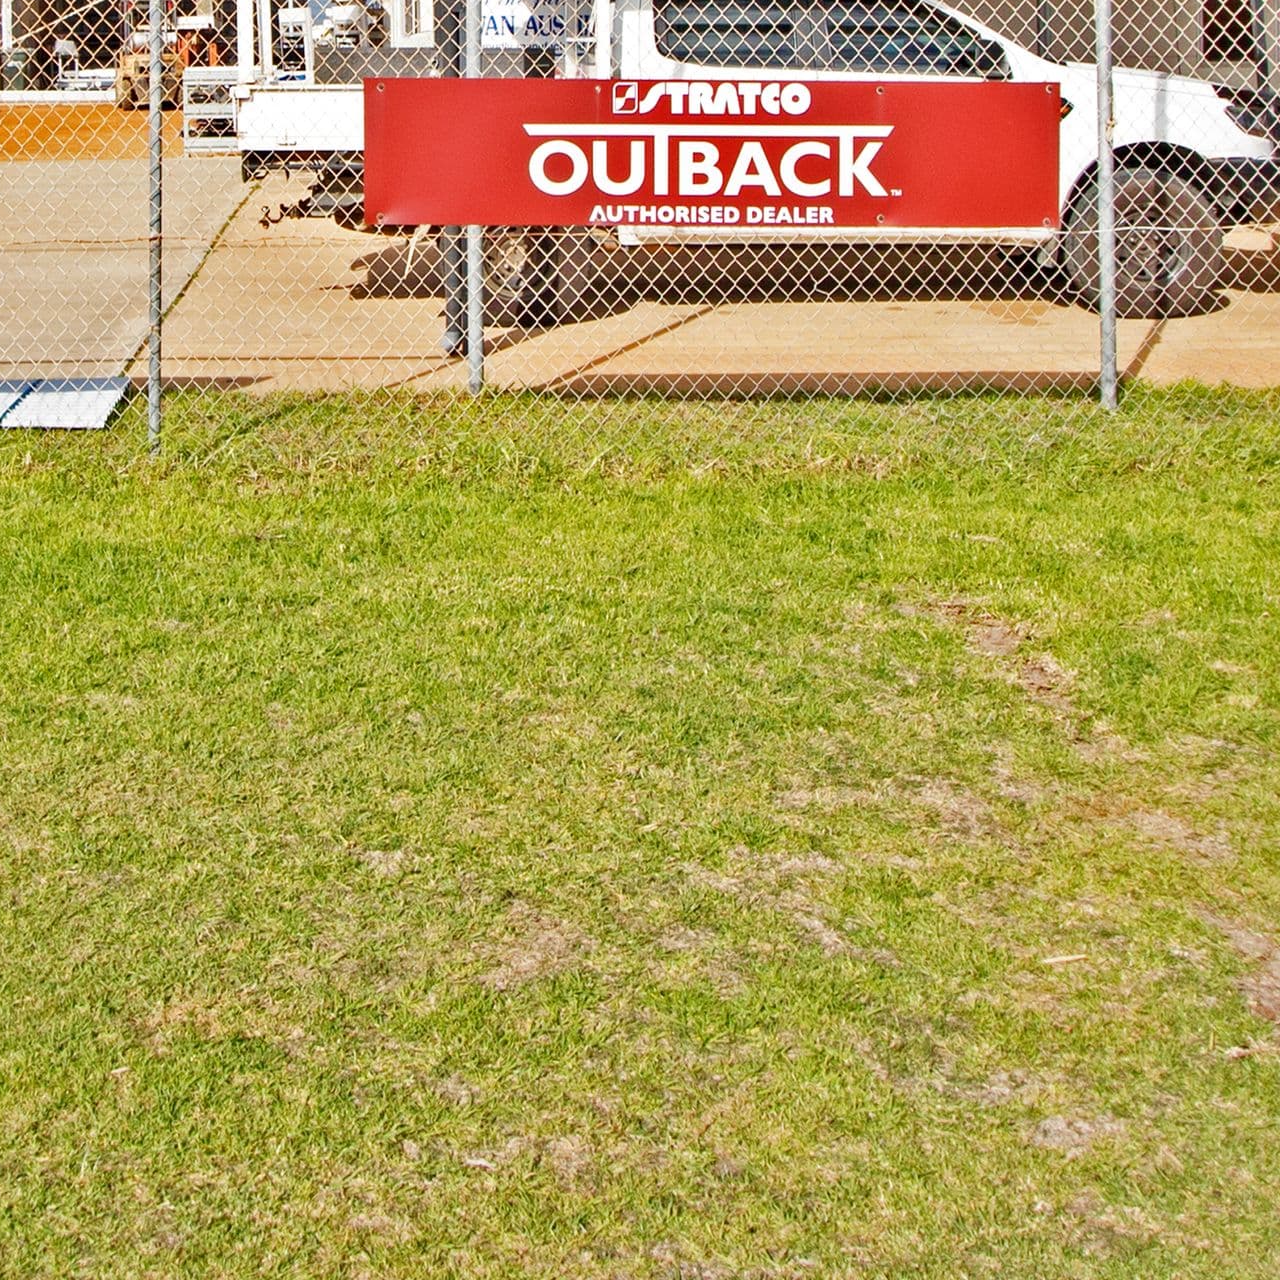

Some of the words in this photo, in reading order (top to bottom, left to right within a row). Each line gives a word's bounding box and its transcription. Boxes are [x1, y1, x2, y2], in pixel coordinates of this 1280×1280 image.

[639, 82, 811, 115] STRATCO
[523, 124, 895, 197] OUTBACK
[589, 205, 740, 224] AUTHORISED
[746, 206, 835, 224] DEALER
